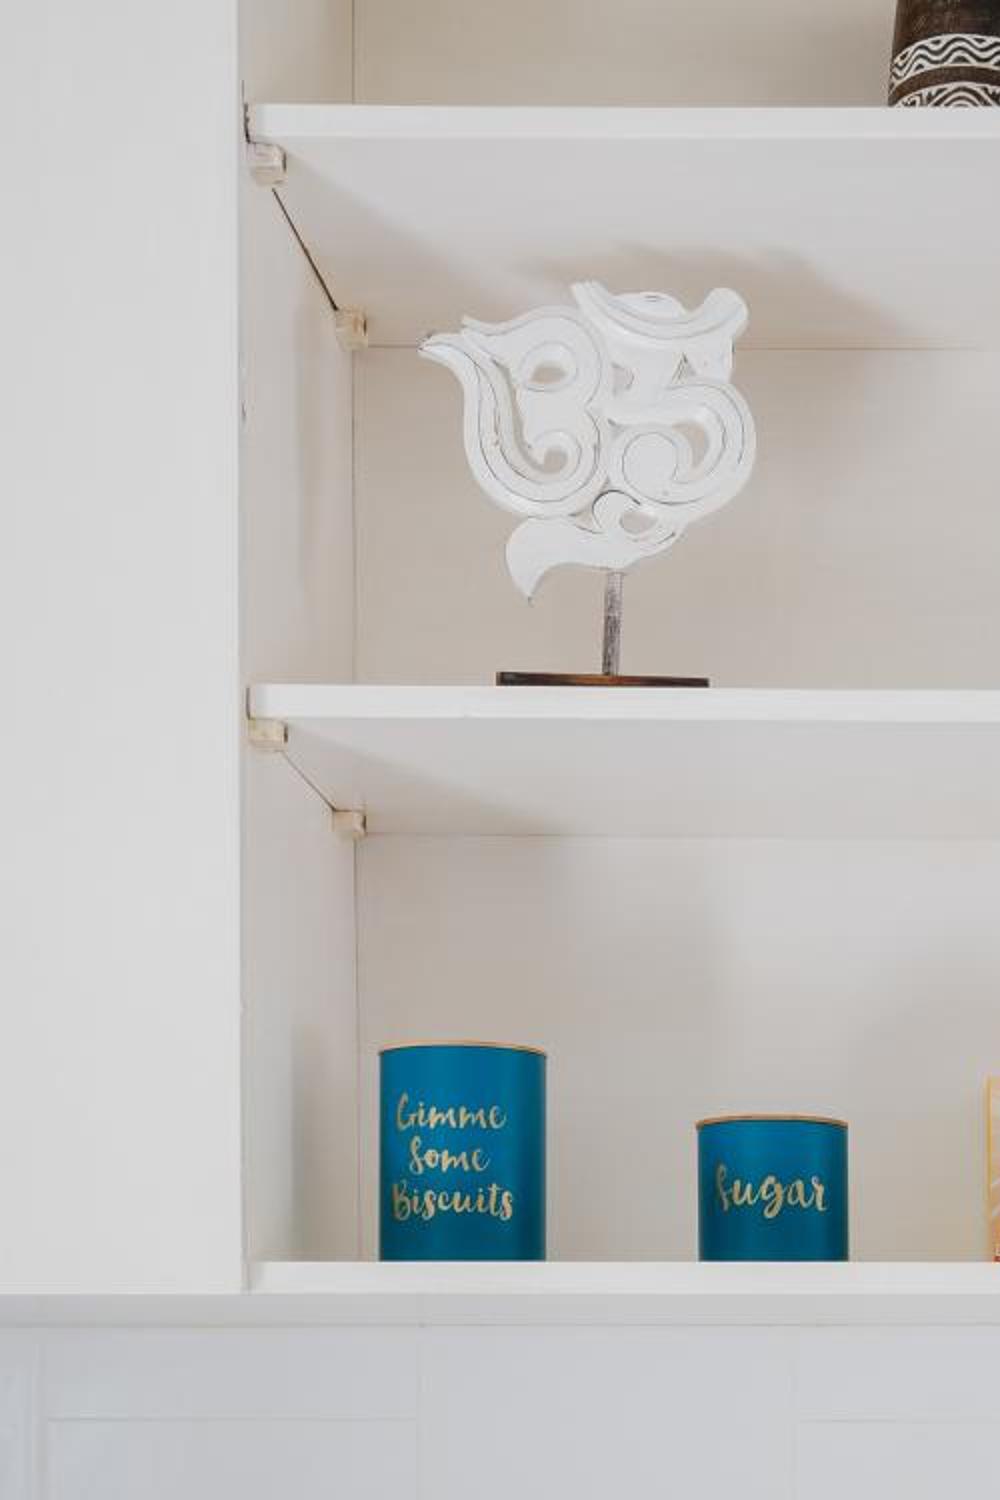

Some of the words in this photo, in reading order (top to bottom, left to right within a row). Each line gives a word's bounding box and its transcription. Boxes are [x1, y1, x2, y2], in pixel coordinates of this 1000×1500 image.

[396, 1092, 507, 1131] Gimme
[409, 1135, 490, 1175] Some
[391, 1180, 514, 1221] Biscuits
[715, 1164, 827, 1219] Sugar
